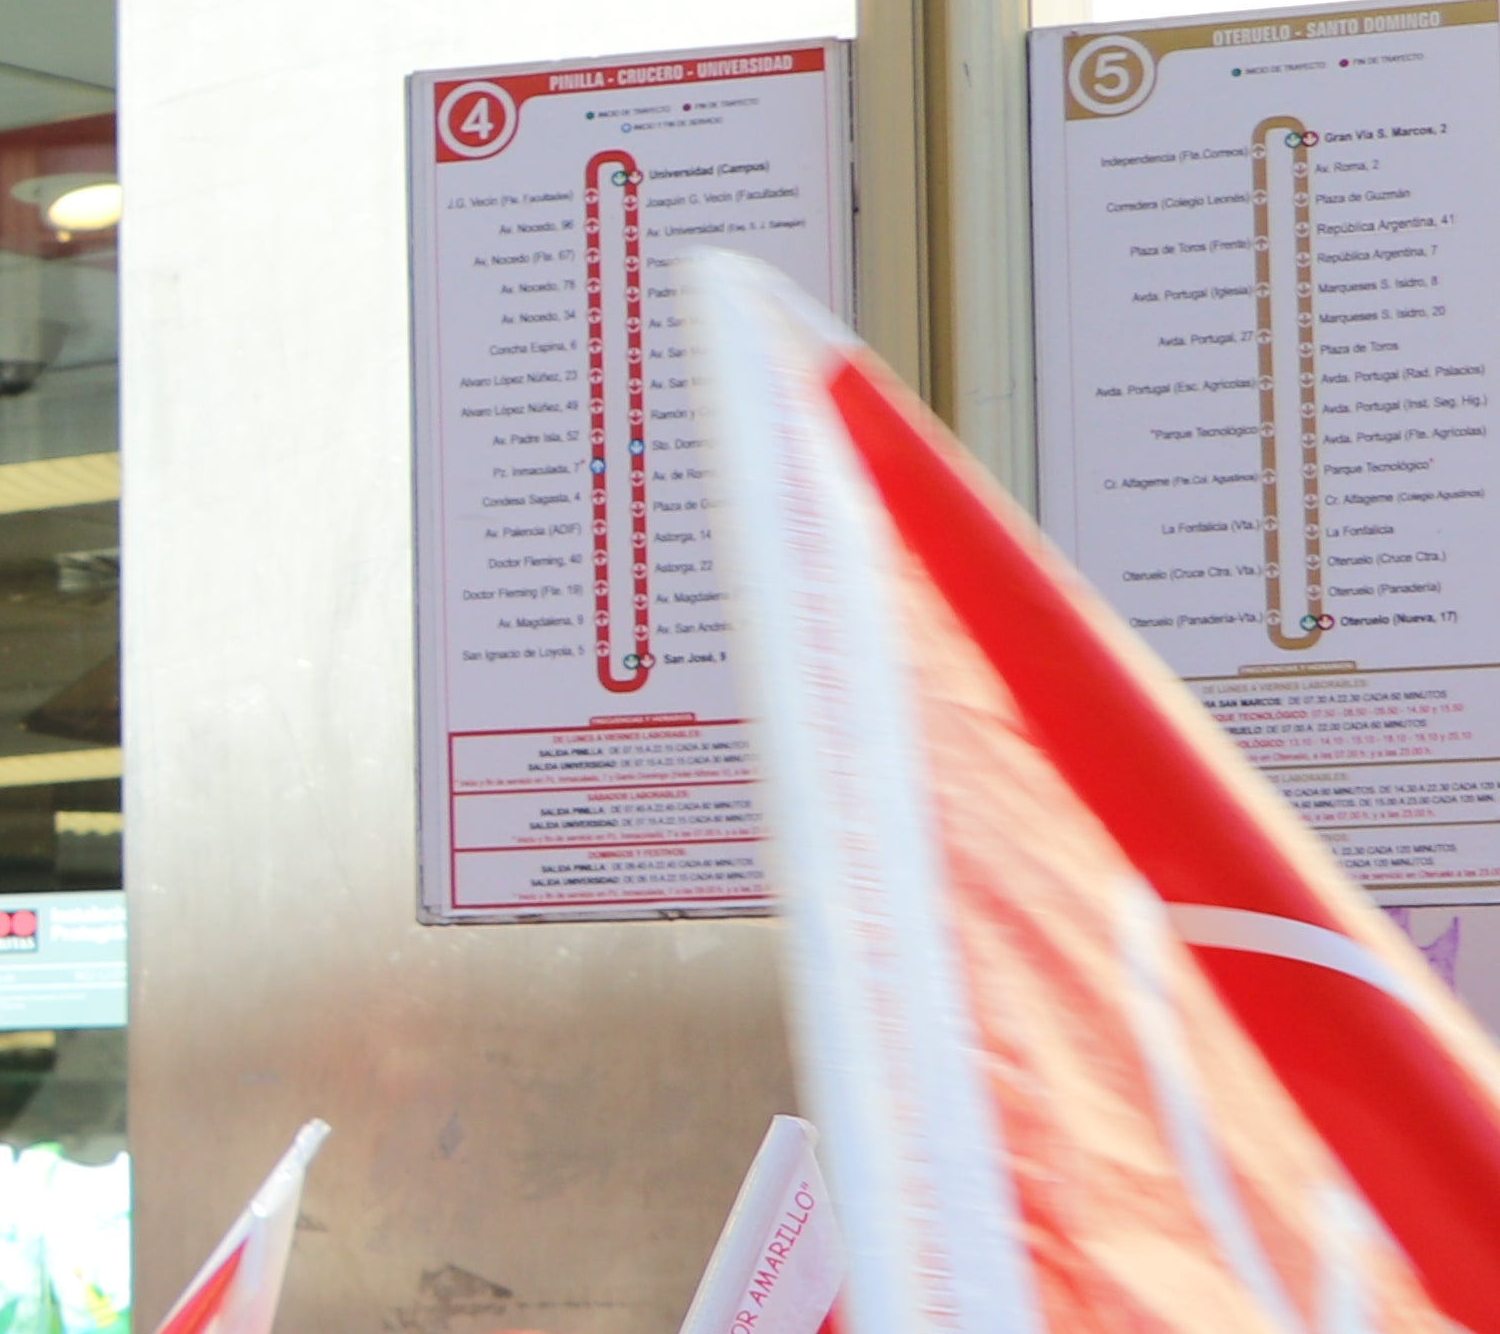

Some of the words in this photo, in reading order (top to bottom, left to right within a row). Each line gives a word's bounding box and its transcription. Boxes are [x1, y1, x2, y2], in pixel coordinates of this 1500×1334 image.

[1213, 26, 1290, 46] OTERUELO
[1306, 18, 1359, 38] SANTO
[1364, 11, 1441, 34] DOMINGO
[549, 72, 604, 91] PINILLA
[618, 65, 684, 84] CRUCERO
[697, 55, 793, 79] UNIVERSIDAD
[1094, 53, 1129, 97] 5
[461, 98, 493, 140] 4
